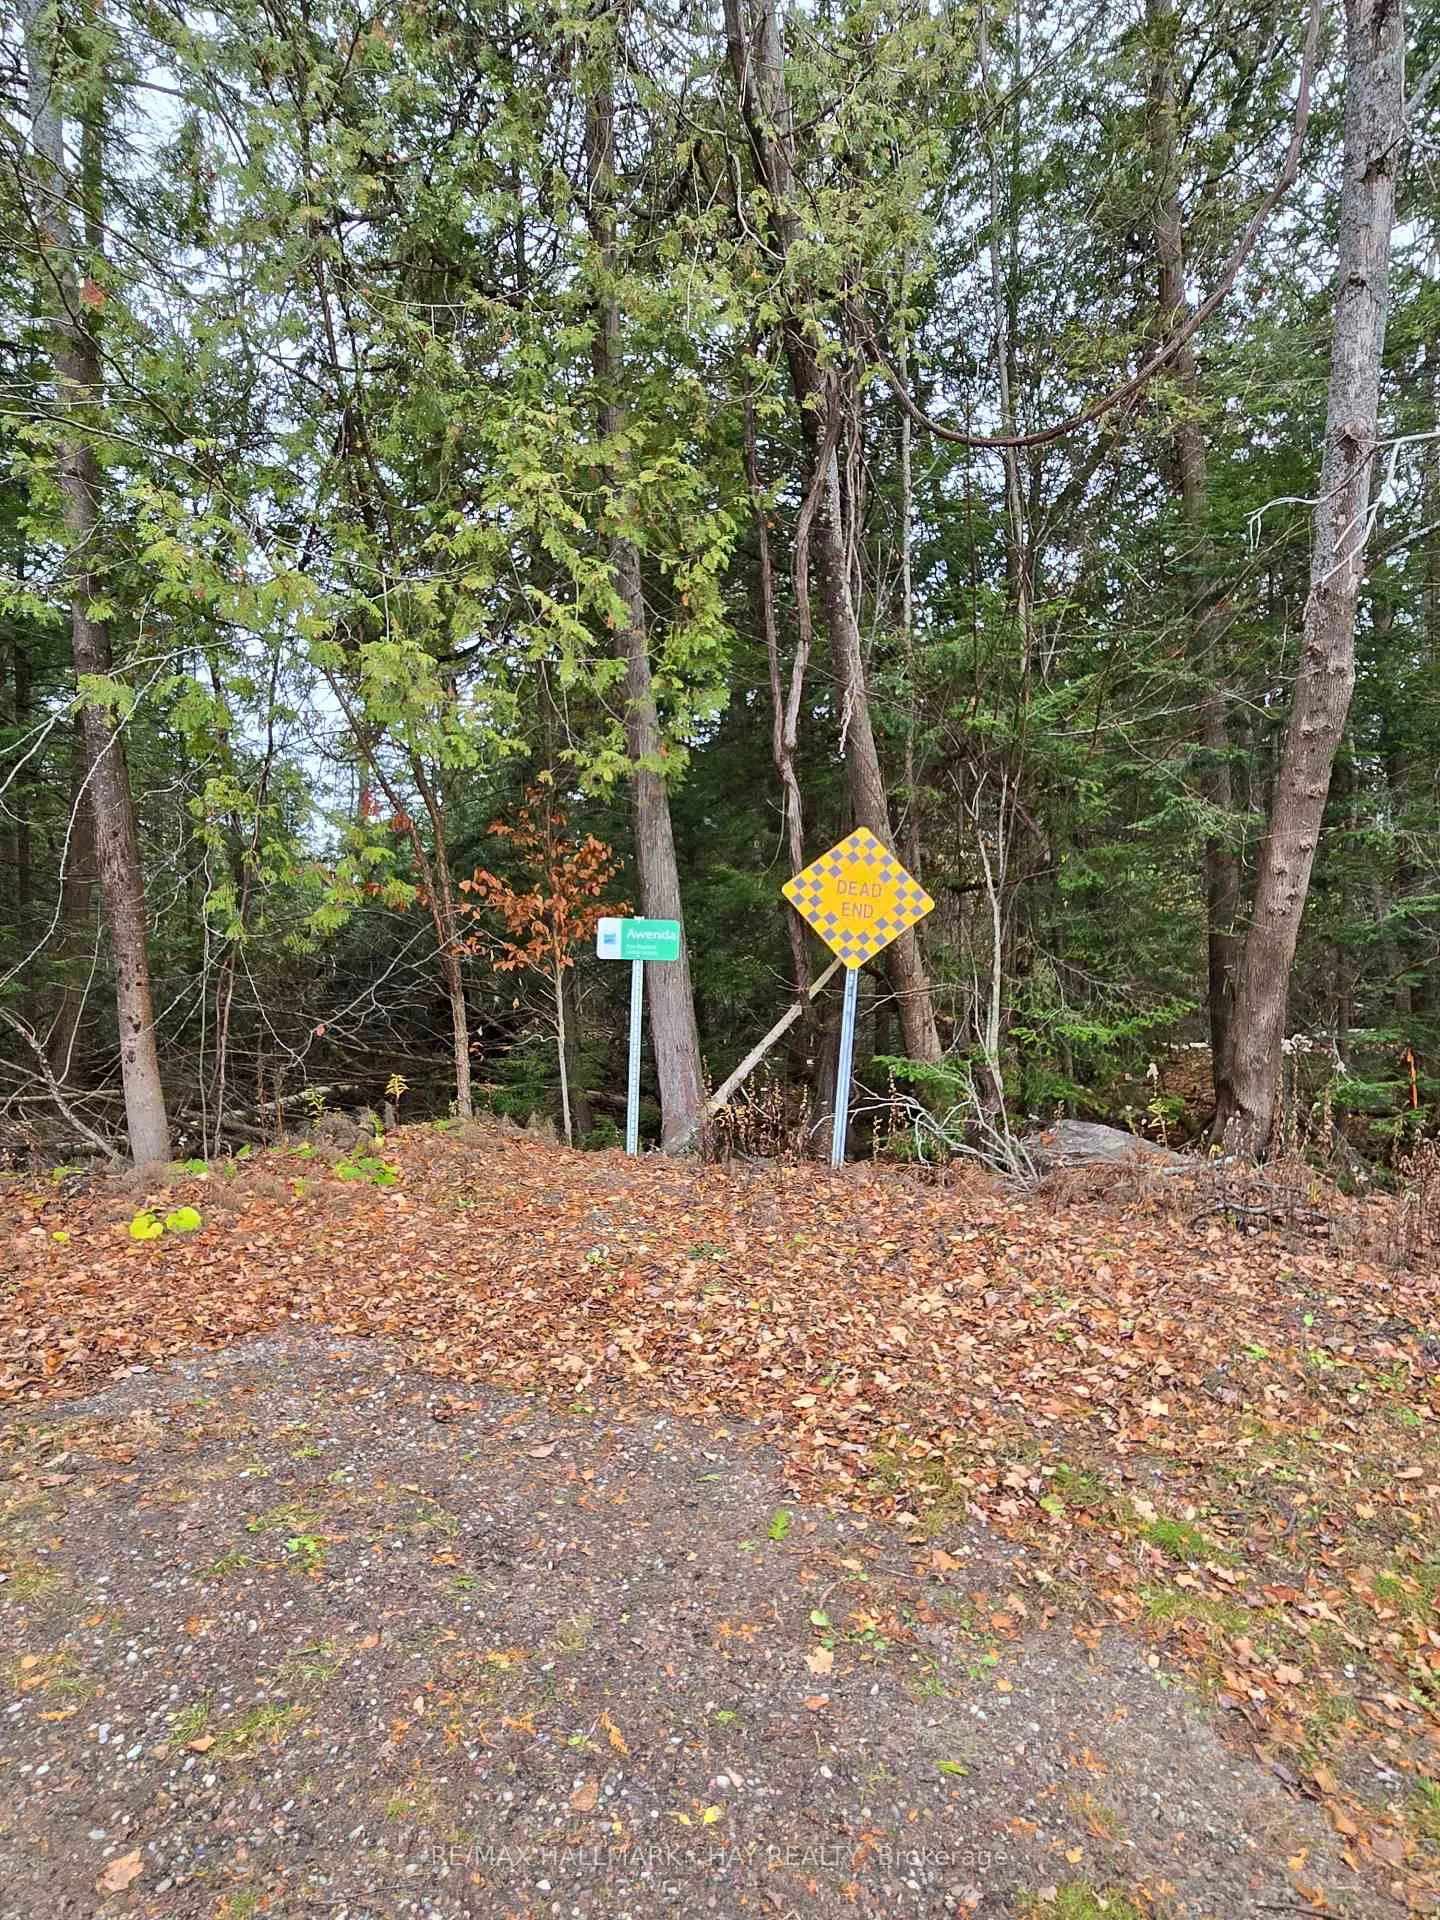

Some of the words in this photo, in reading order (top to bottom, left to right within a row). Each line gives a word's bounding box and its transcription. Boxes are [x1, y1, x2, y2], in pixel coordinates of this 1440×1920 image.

[836, 879, 882, 898] DEAD
[841, 902, 874, 919] END
[626, 928, 677, 941] Awenda
